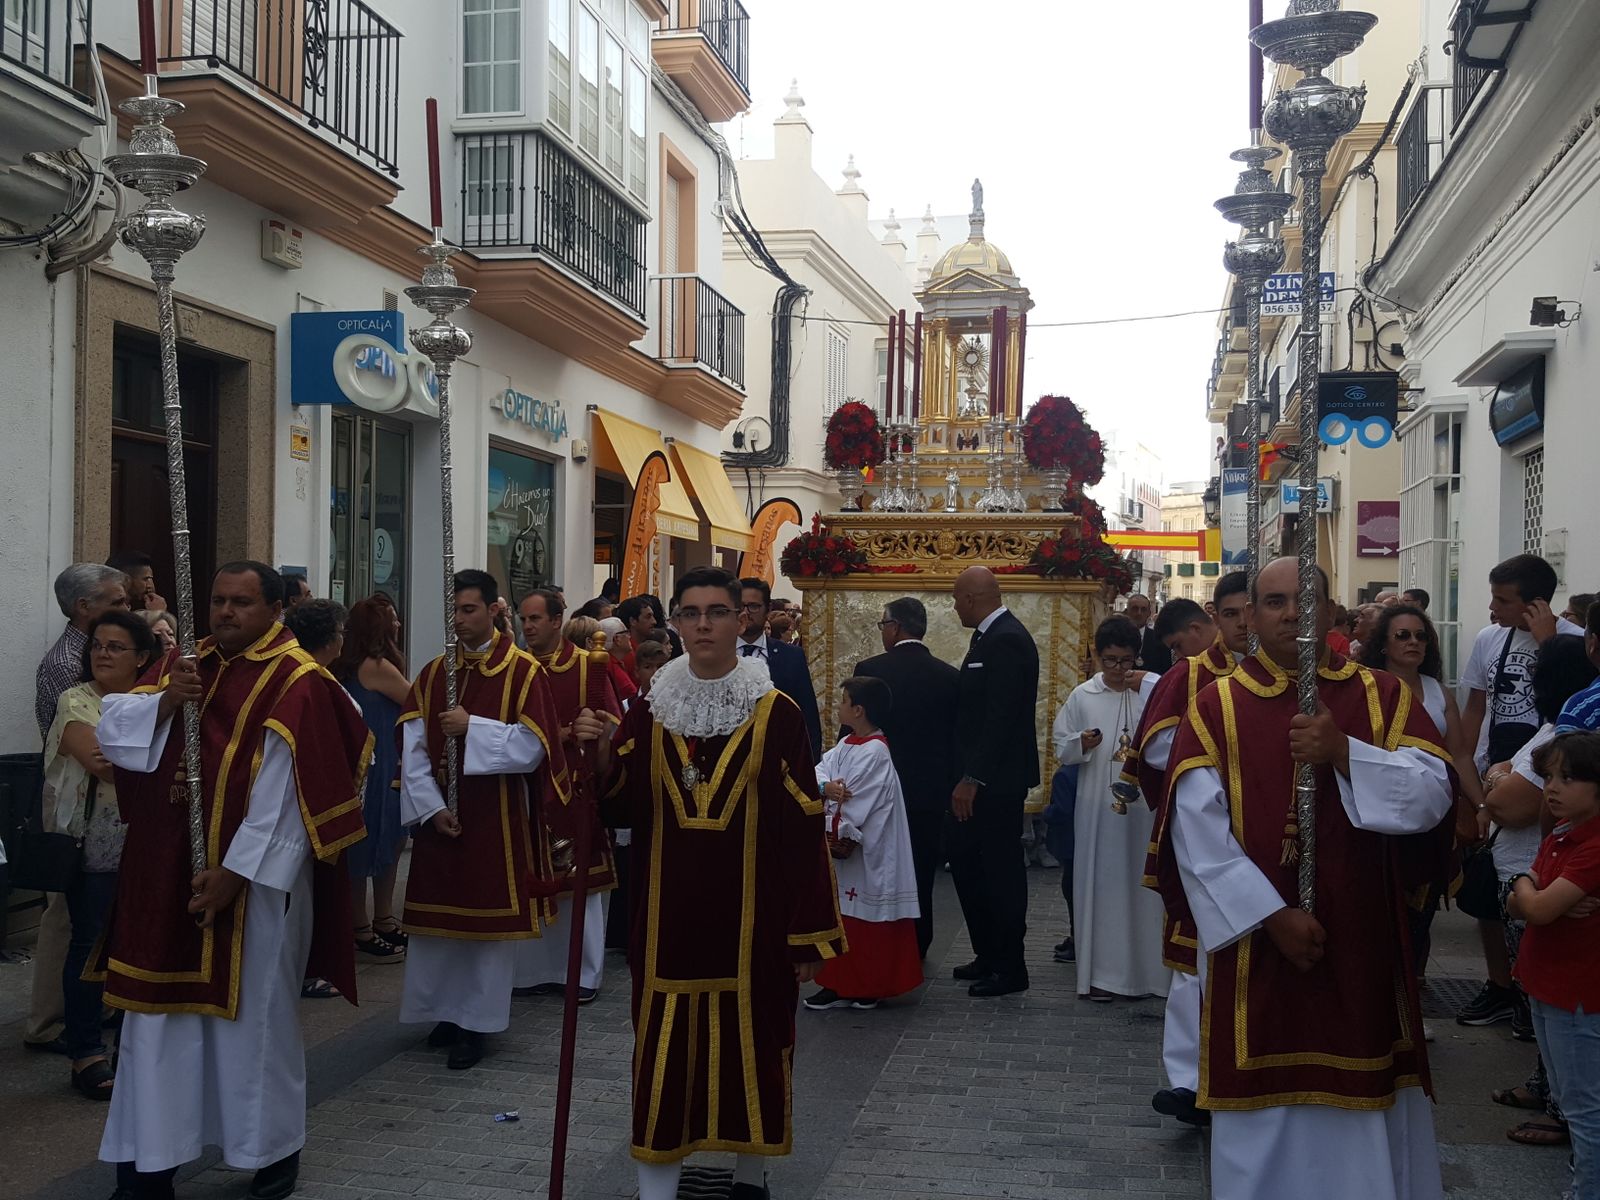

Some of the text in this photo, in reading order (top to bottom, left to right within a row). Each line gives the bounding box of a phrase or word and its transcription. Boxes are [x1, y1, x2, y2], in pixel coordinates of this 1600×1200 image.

[1264, 275, 1333, 289] CLÍNA
[1266, 290, 1333, 302] DENL
[1264, 304, 1284, 314] 956
[1496, 704, 1518, 714] 1971
